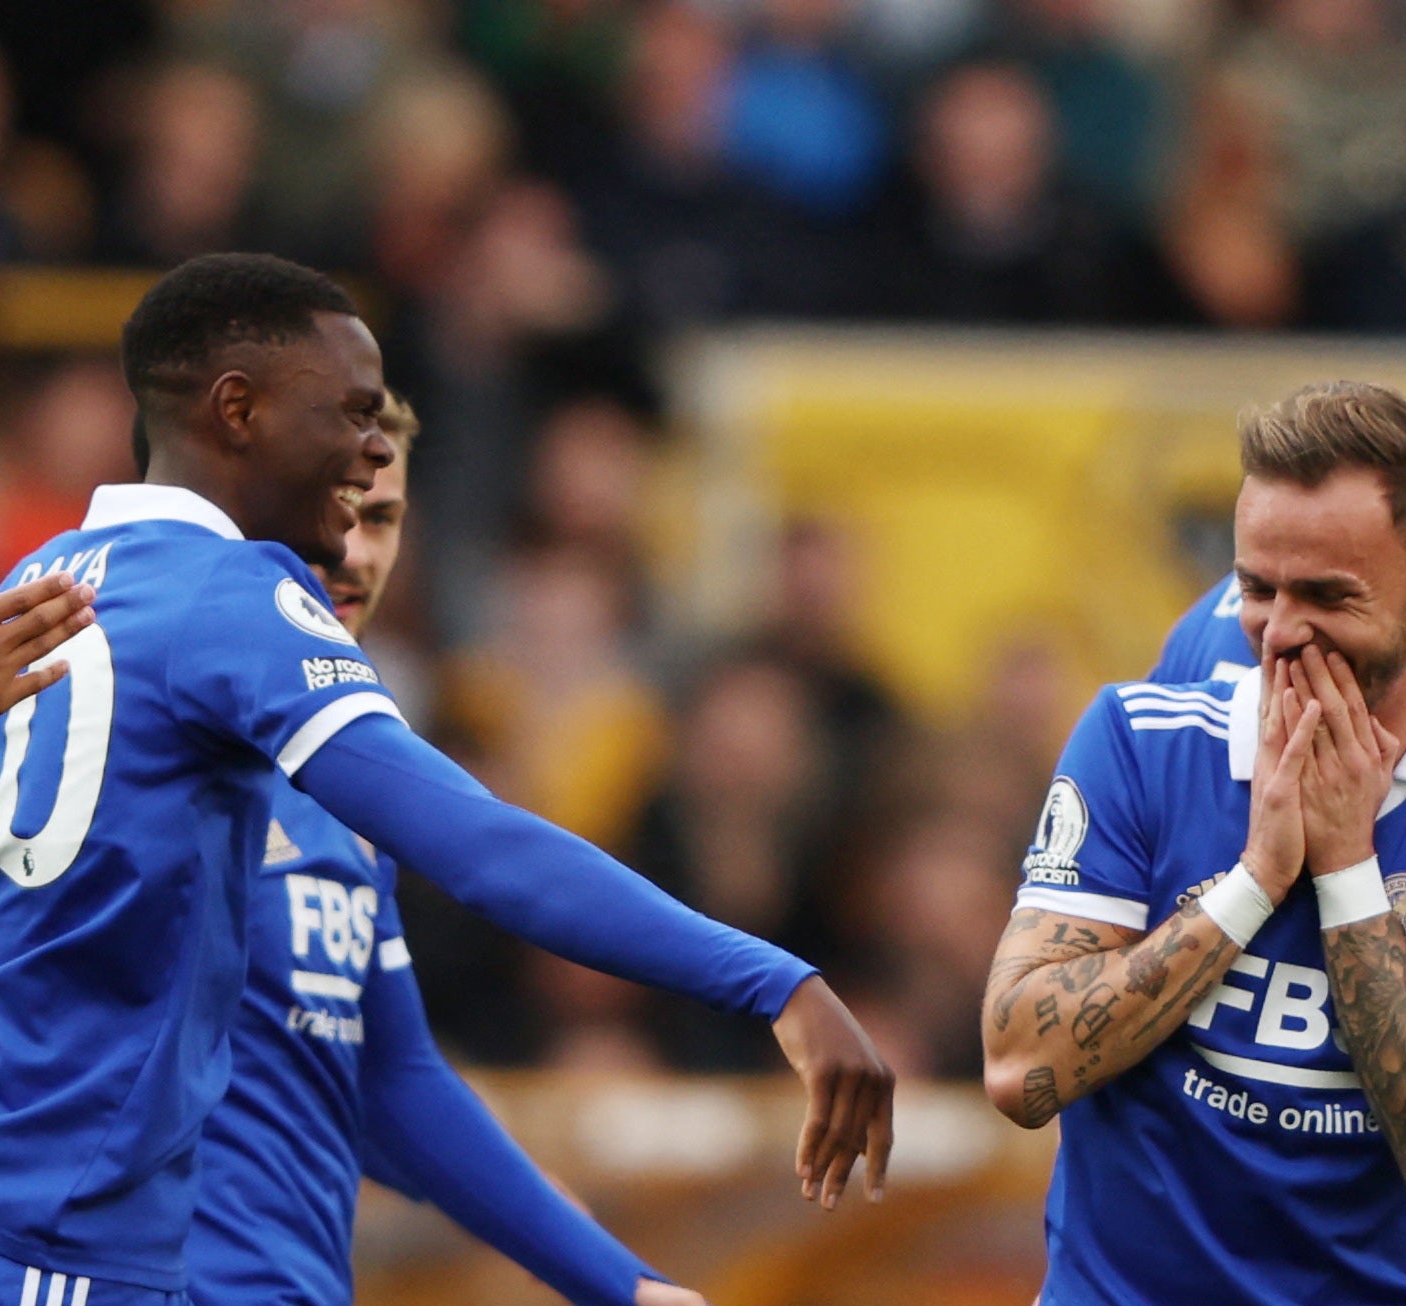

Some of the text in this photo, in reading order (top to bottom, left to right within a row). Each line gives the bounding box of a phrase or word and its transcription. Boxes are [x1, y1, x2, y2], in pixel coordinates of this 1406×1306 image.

[301, 657, 334, 676] No
[306, 672, 336, 691] for
[285, 873, 378, 976] FBS
[1186, 952, 1349, 1055] FB
[1181, 1067, 1380, 1134] trade online
